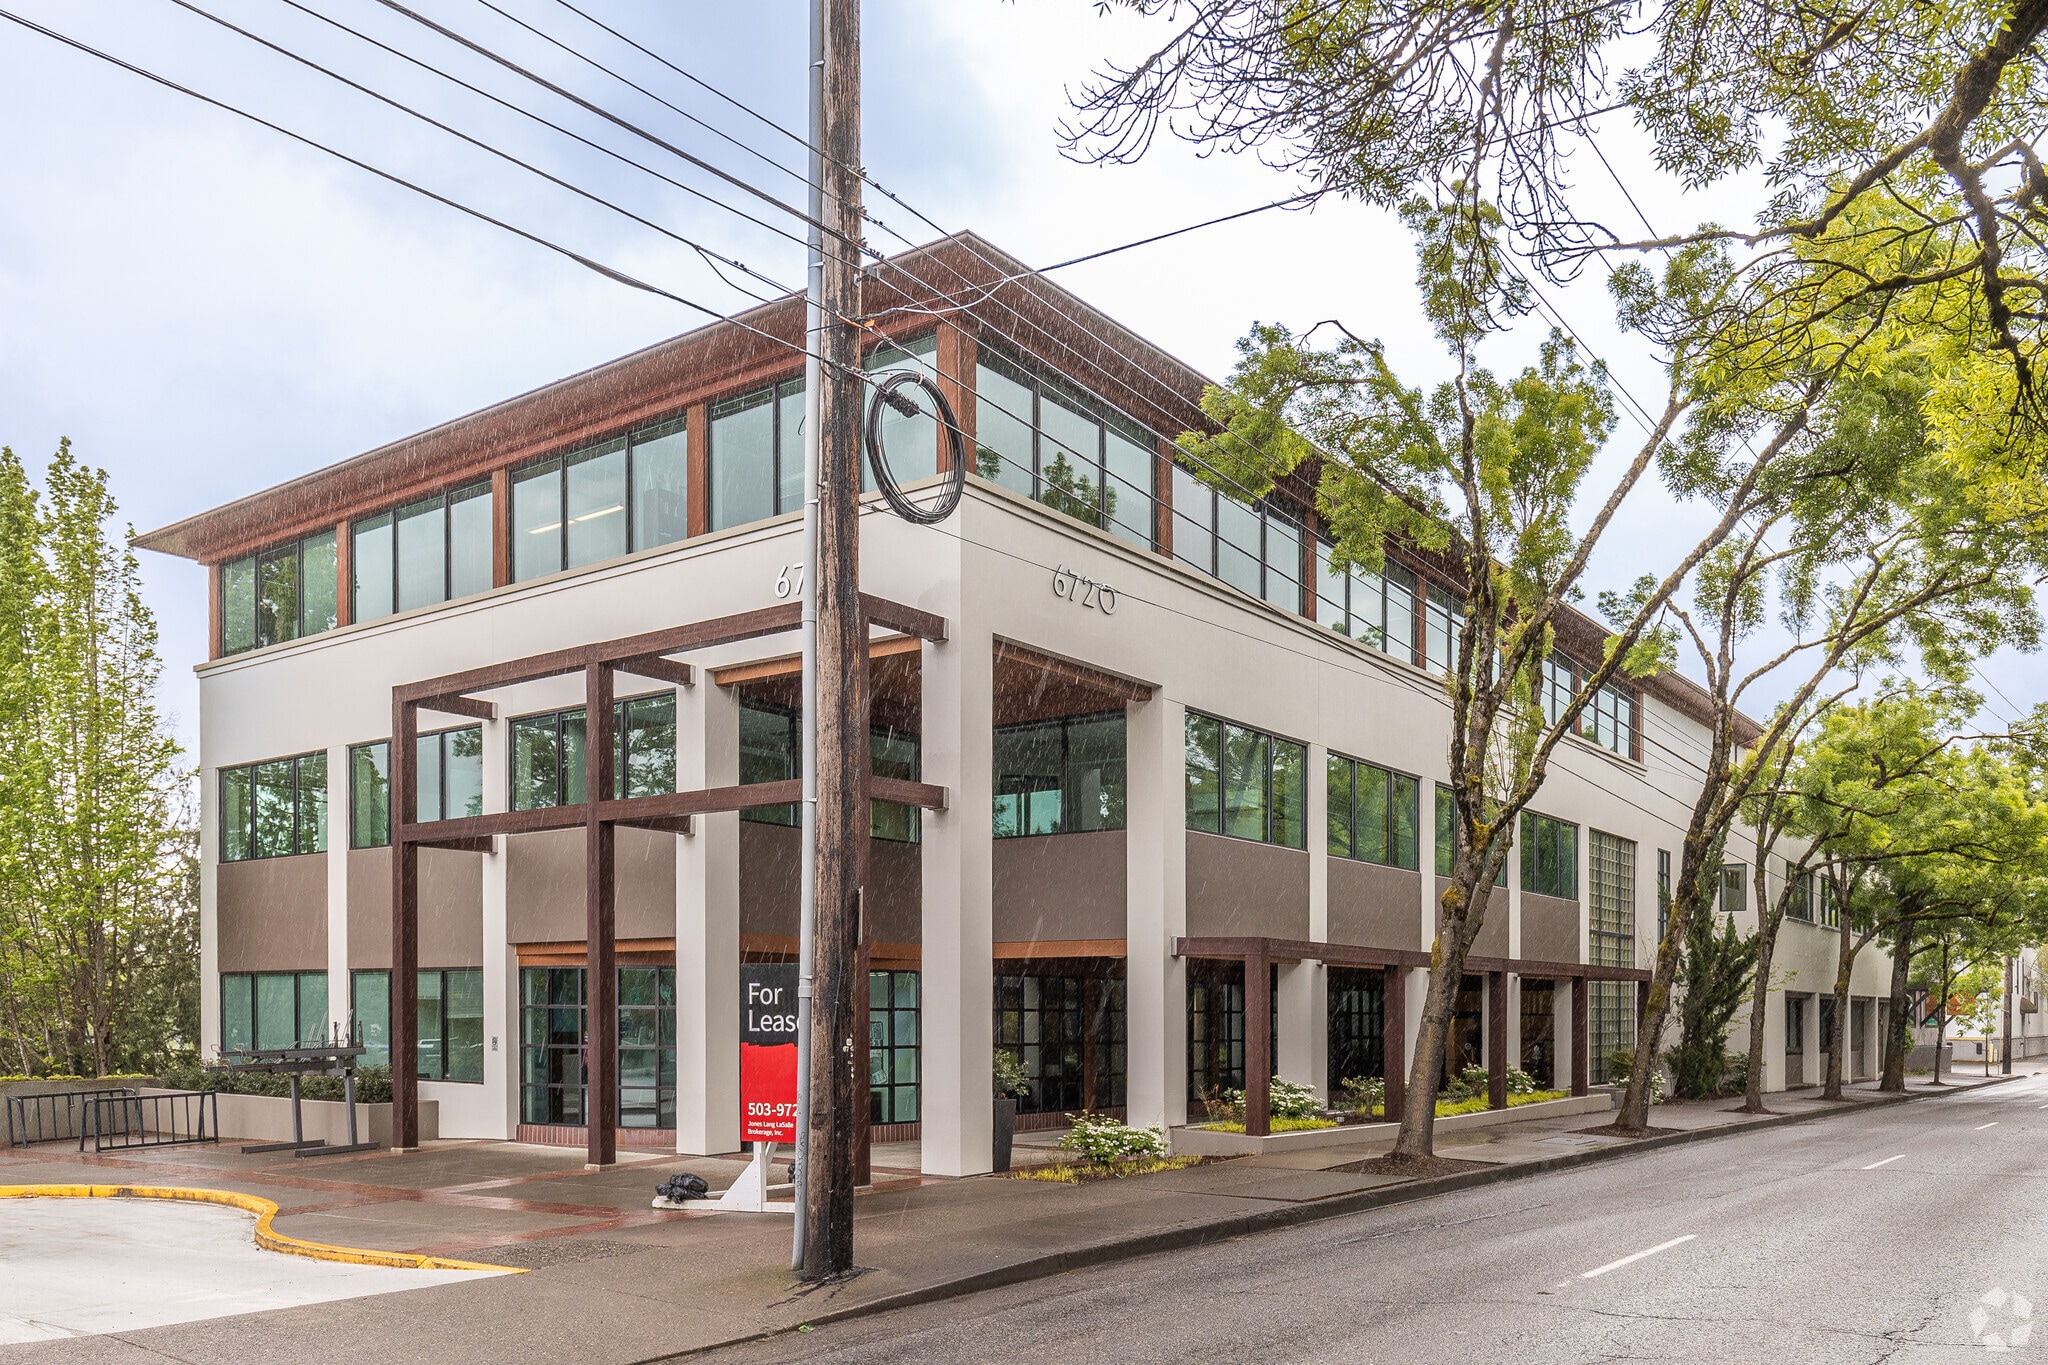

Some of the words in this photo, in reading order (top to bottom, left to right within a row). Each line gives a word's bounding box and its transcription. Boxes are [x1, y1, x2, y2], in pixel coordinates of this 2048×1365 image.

[1053, 564, 1118, 615] 6720
[748, 982, 783, 1005] For
[748, 1009, 800, 1032] Leas
[747, 1102, 798, 1117] 503-972
[747, 1128, 774, 1137] Brokerage,
[763, 1121, 776, 1129] Lang
